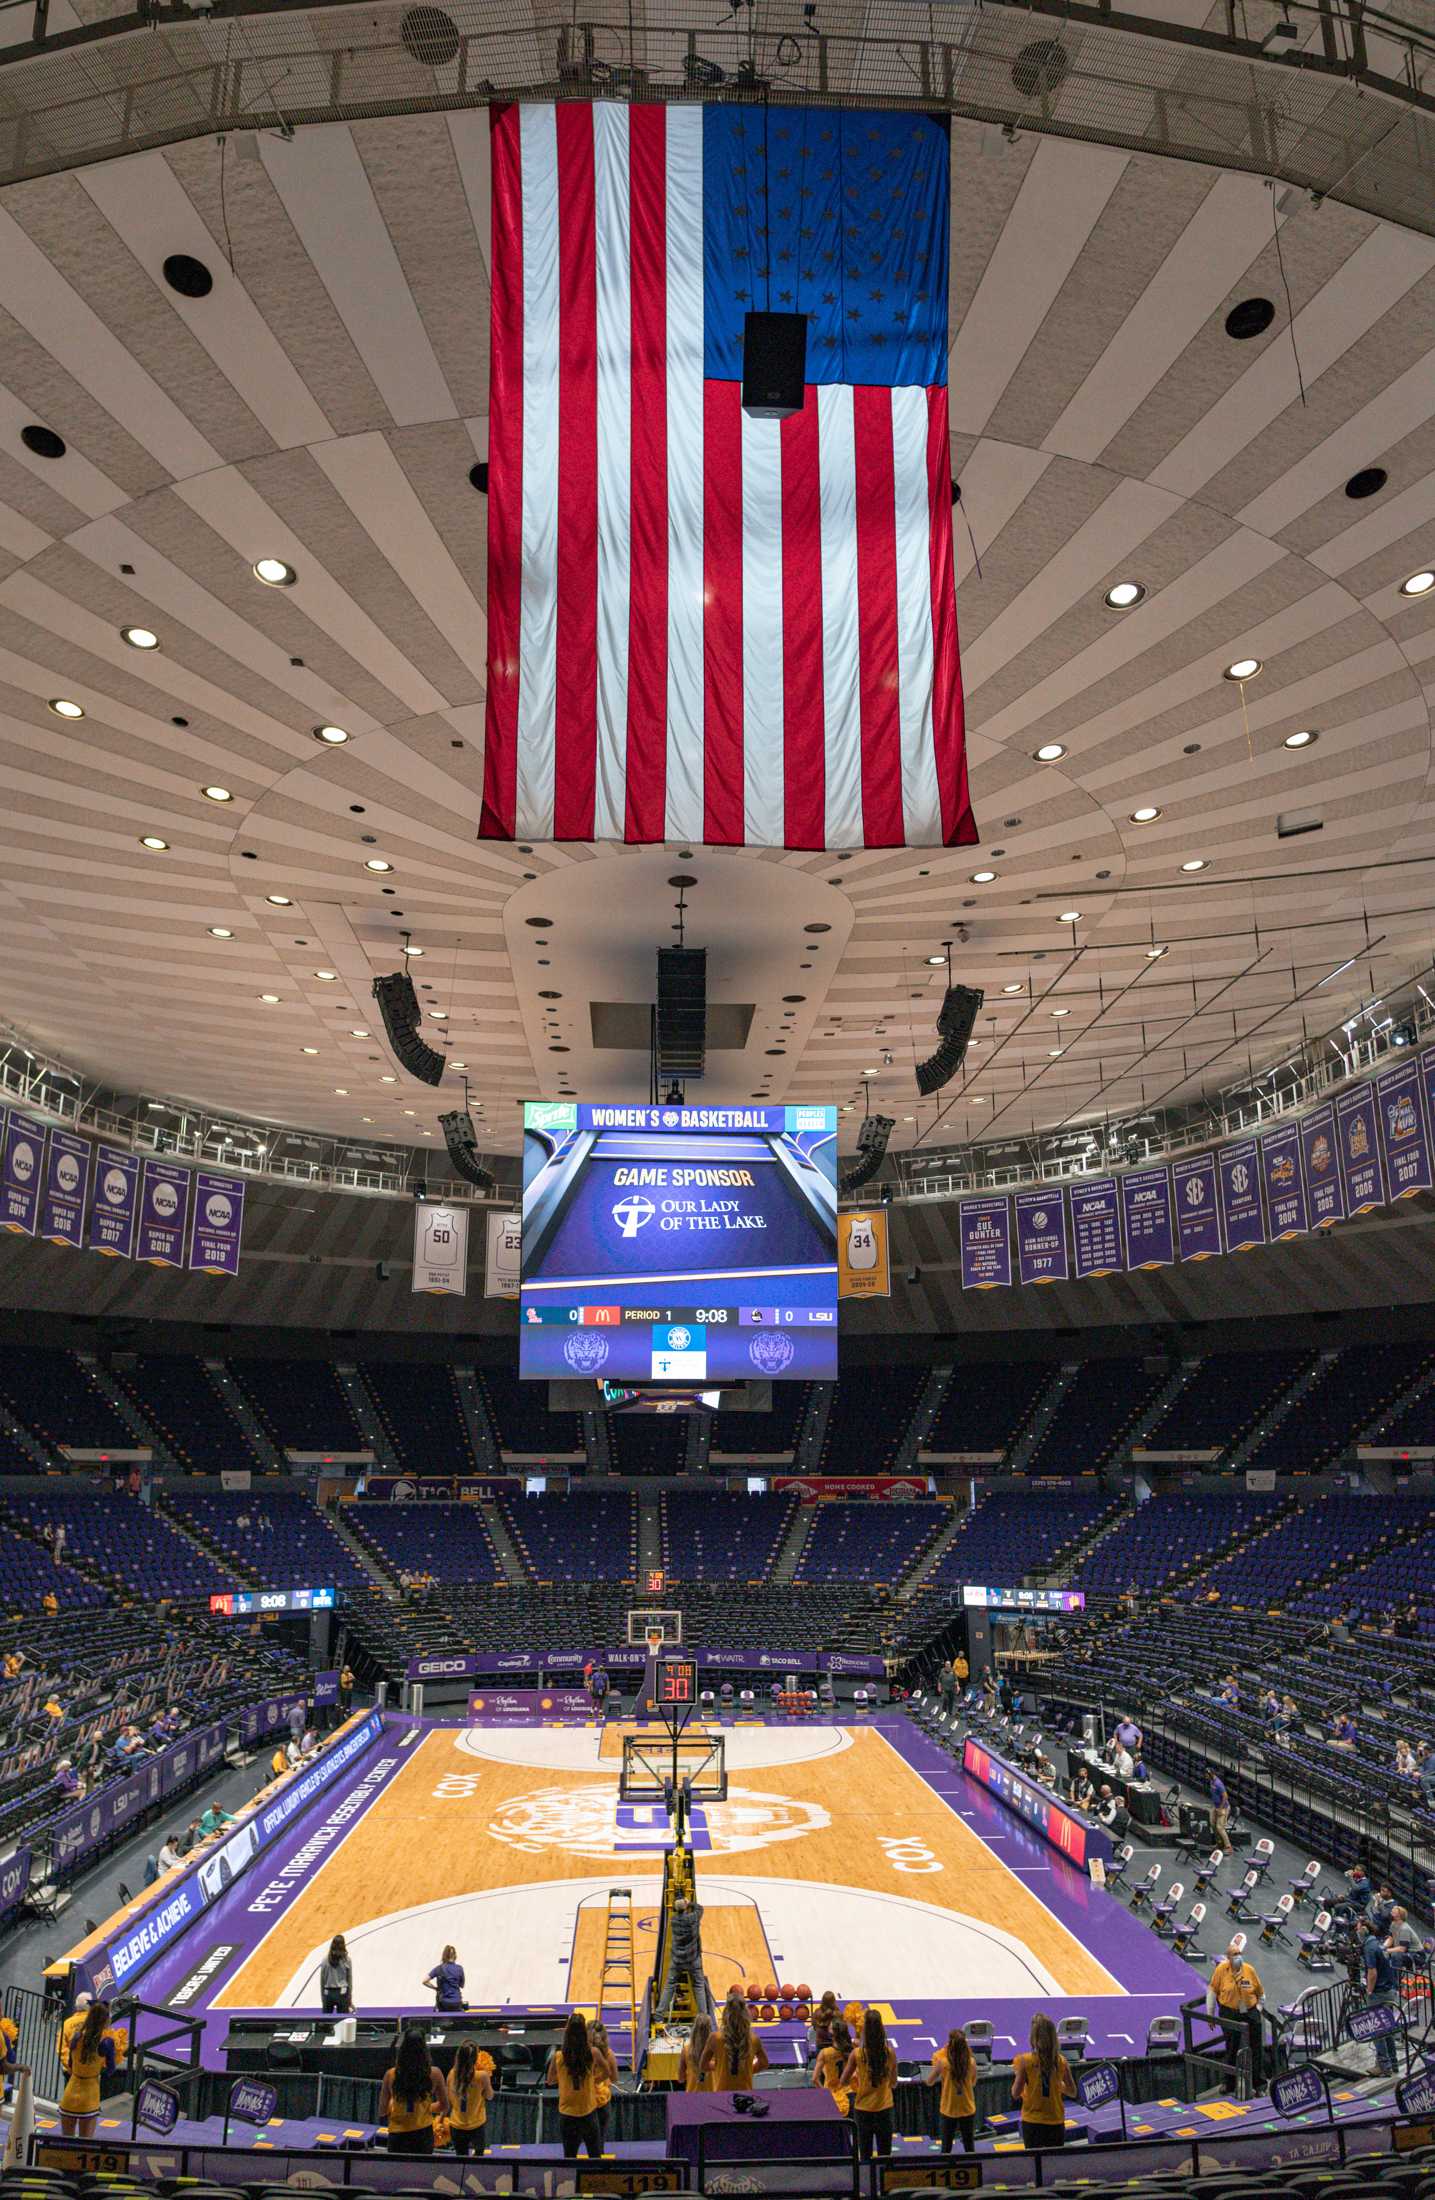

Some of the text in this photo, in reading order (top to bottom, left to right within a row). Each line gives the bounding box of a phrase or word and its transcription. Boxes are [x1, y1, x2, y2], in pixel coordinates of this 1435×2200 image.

[591, 1108, 769, 1128] WOMEN'S BASKETBALL
[15, 1158, 32, 1172] NCAA
[1399, 1163, 1418, 1181] 2007
[60, 1170, 78, 1184] NCAA
[613, 1168, 756, 1187] GAME SPONSOR
[1231, 1164, 1249, 1193] SEC
[106, 1183, 126, 1197] NCAA
[1134, 1190, 1157, 1203] NCAA
[1185, 1177, 1205, 1206] SEC
[1355, 1181, 1373, 1198] 2006
[155, 1197, 176, 1209] NCAA
[661, 1199, 740, 1213] OUR LADY
[1082, 1200, 1106, 1213] NCAA
[208, 1209, 232, 1220] NCAA
[1278, 1210, 1297, 1225] 2004
[660, 1214, 768, 1231] OF THE LAKE
[976, 1221, 993, 1231] SUE
[102, 1229, 120, 1242] 2017
[433, 1229, 450, 1244] 50
[854, 1234, 871, 1248] 34
[969, 1229, 1001, 1240] GUNTER
[151, 1240, 171, 1253] 2018
[505, 1236, 520, 1250] 23
[205, 1249, 226, 1262] 2019
[1033, 1258, 1053, 1269] 1977
[569, 1309, 578, 1320] 0
[624, 1309, 728, 1323] PERIOD 1 9:08
[785, 1311, 833, 1322] 0 LSU
[461, 1486, 496, 1499] BELL
[649, 1579, 661, 1590] 30
[240, 1602, 247, 1612] 0
[261, 1595, 287, 1608] 9:08
[301, 1599, 307, 1607] 0
[992, 1596, 998, 1605] 0
[548, 1654, 583, 1665] Community
[608, 1653, 646, 1662] WALK-ON'S
[771, 1657, 787, 1665] TACO
[418, 1659, 466, 1674] GEICO
[664, 1678, 688, 1699] 30
[496, 1695, 518, 1705] Rhythm
[564, 1695, 585, 1705] Rhythm
[432, 1772, 482, 1799] COX
[248, 1880, 296, 1912] PETE
[278, 1826, 342, 1877] MARAVICH
[326, 1783, 376, 1824] ASSEMBLY
[363, 1758, 399, 1783] CENTER
[876, 1836, 945, 1873] COX
[2, 1865, 23, 1898] COX
[112, 1930, 151, 1978] BELIEVE
[147, 1922, 159, 1944] &
[168, 1946, 233, 2006] TIGERS UNITED
[15, 2137, 23, 2160] LSU
[77, 2152, 118, 2172] 119
[623, 2175, 669, 2193] 119
[925, 2169, 971, 2187] 119
